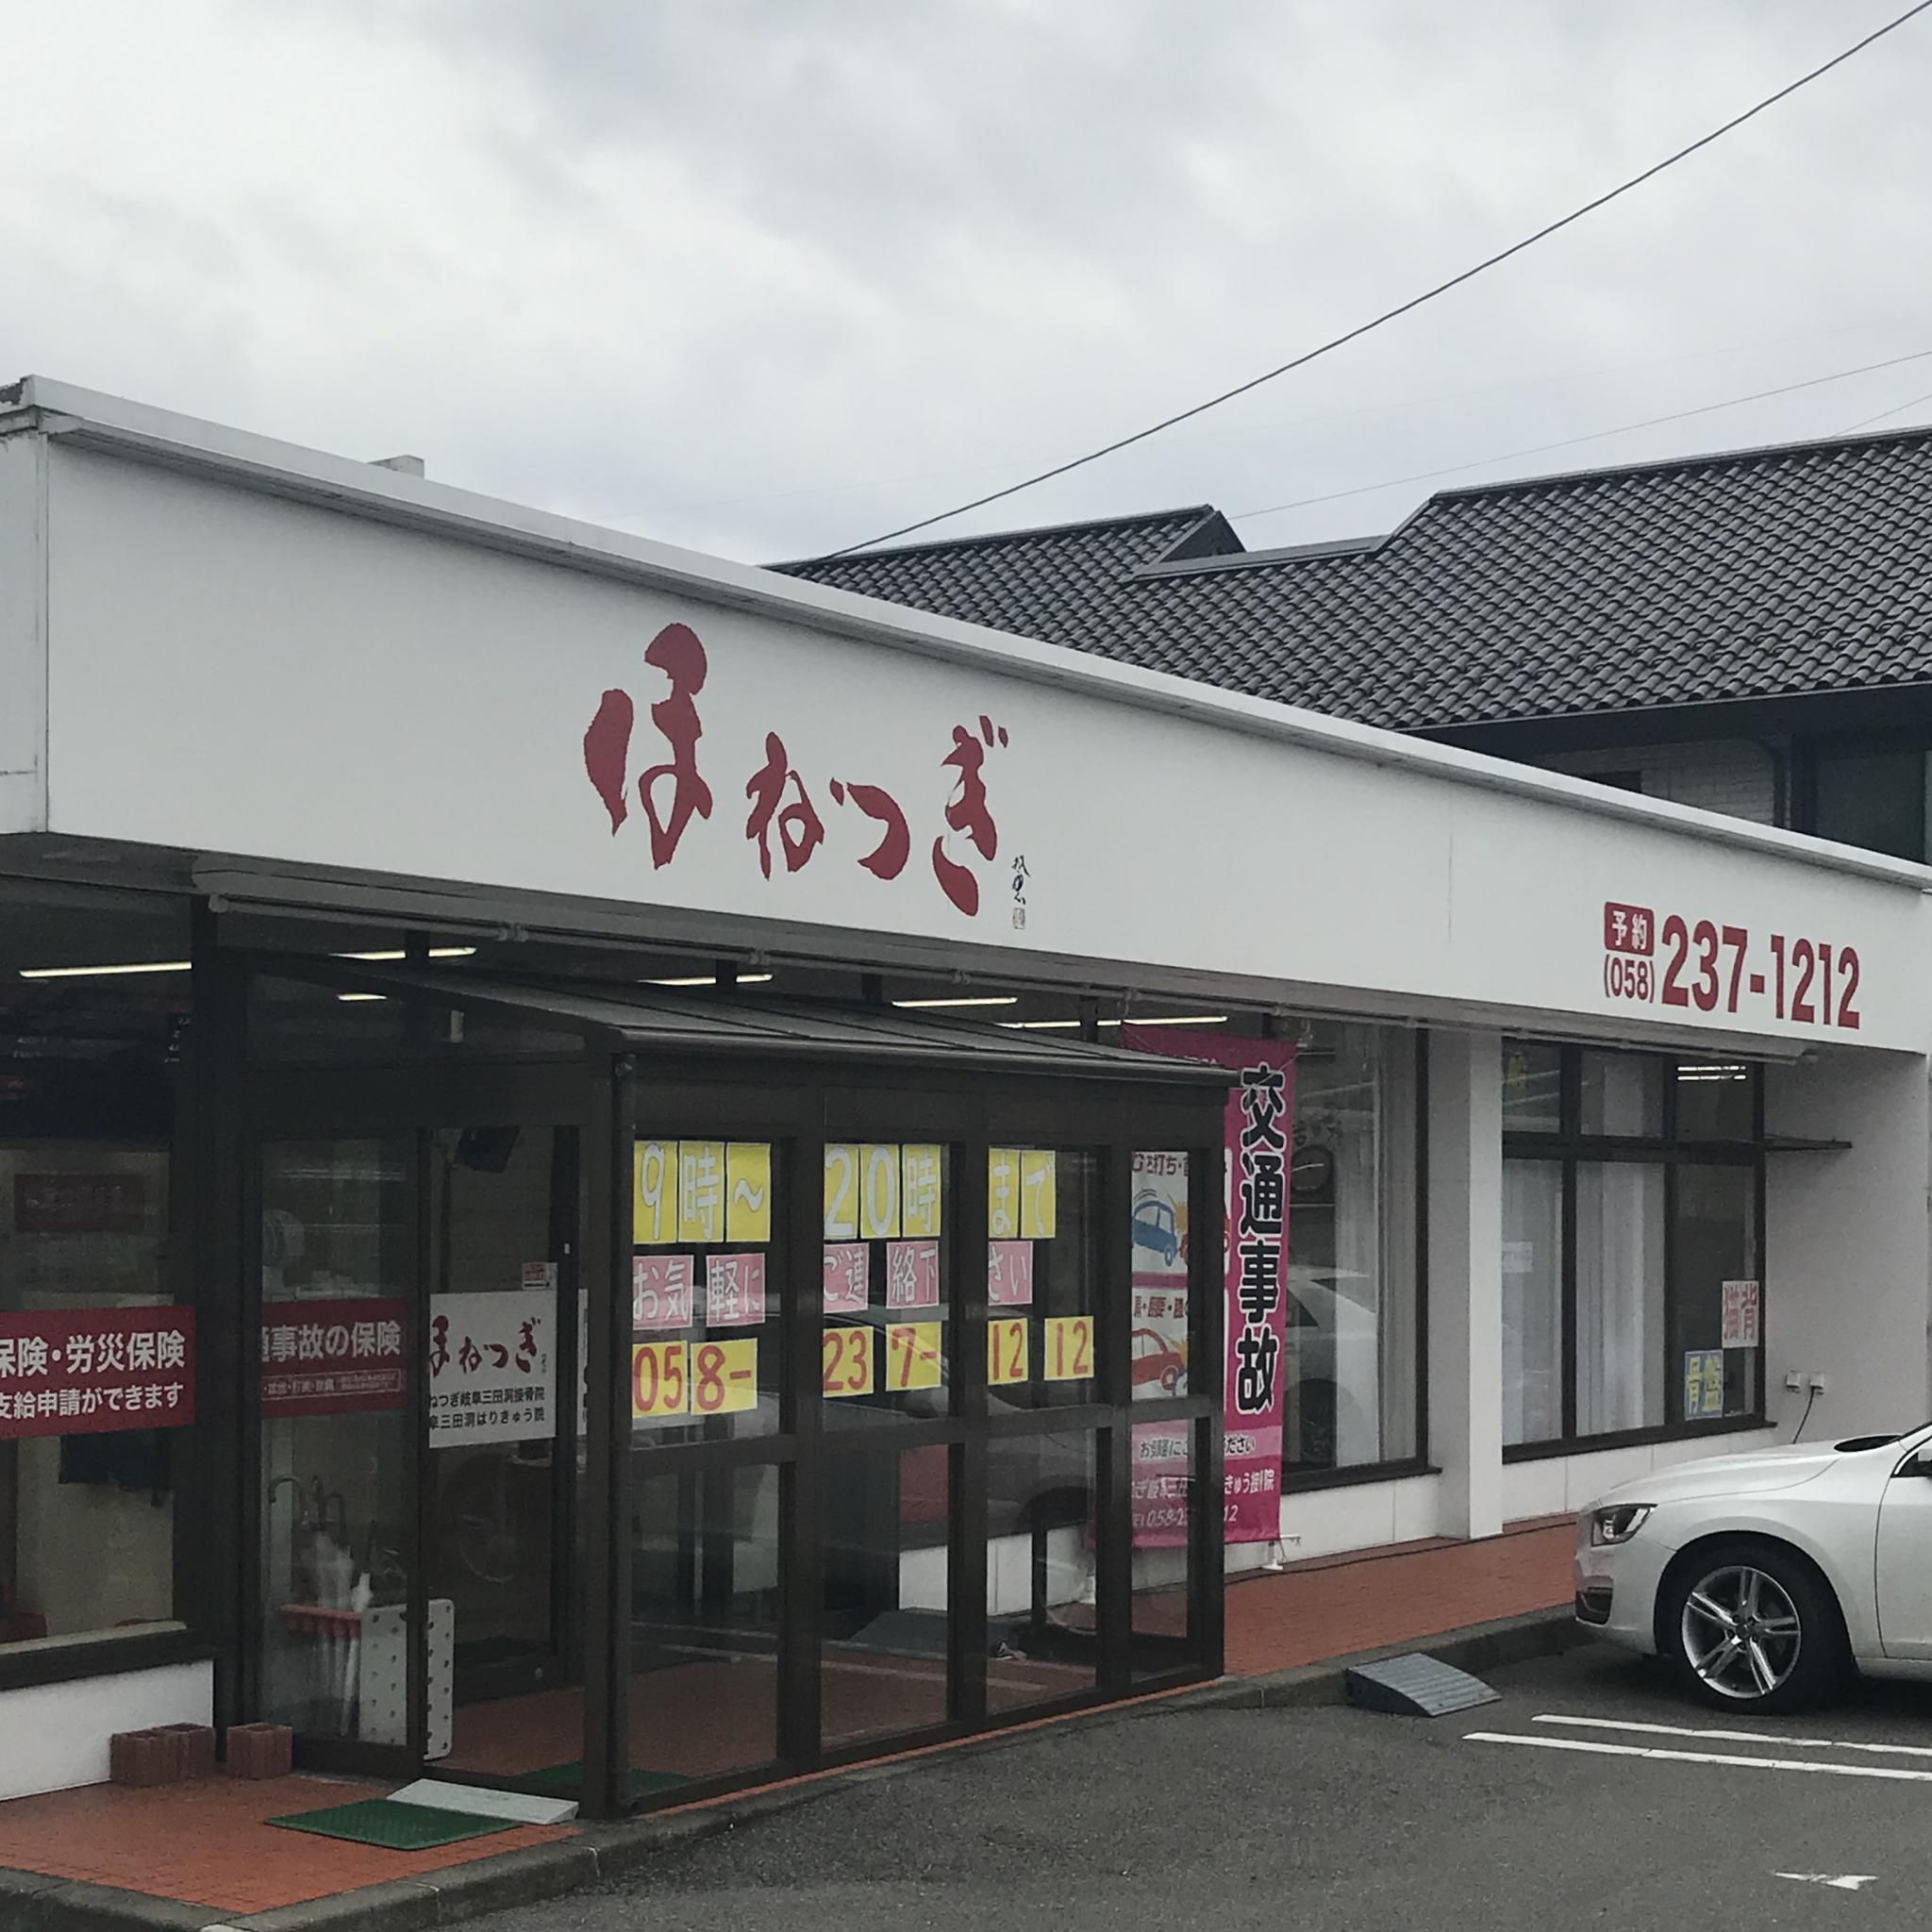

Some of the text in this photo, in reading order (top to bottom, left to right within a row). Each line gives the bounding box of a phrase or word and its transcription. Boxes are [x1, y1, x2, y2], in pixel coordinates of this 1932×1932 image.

[584, 623, 1008, 916] ほねつぎ
[1605, 915, 1860, 1029] (058) 237-1212
[1611, 910, 1648, 950] 予約
[825, 1145, 938, 1233] 20時
[993, 1153, 1054, 1234] まで
[1238, 1063, 1286, 1413] 交通事故
[634, 1258, 760, 1322] お気軽に
[262, 1321, 401, 1362] 事故の保険
